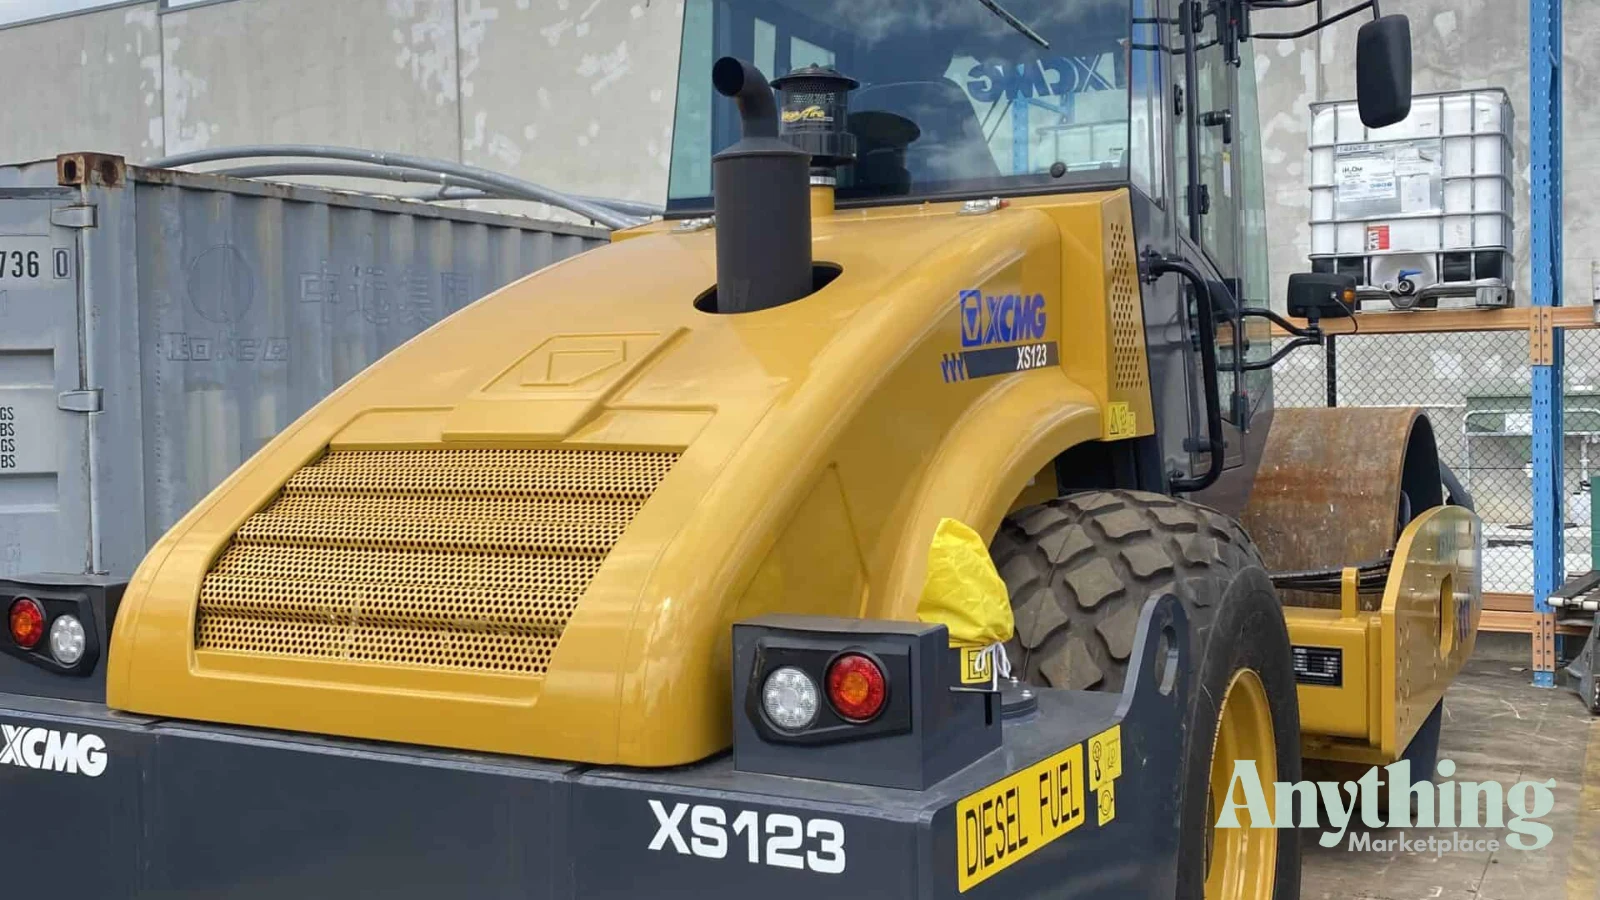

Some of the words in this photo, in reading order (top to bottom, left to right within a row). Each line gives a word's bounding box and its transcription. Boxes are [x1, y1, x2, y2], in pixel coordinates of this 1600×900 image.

[56, 250, 68, 277] 0
[983, 293, 1046, 344] XCMG
[1016, 344, 1047, 370] XS123
[0, 723, 108, 778] XCMG
[647, 799, 846, 875] XS123
[965, 788, 1029, 878] DIESEL
[1039, 760, 1080, 831] FUEL
